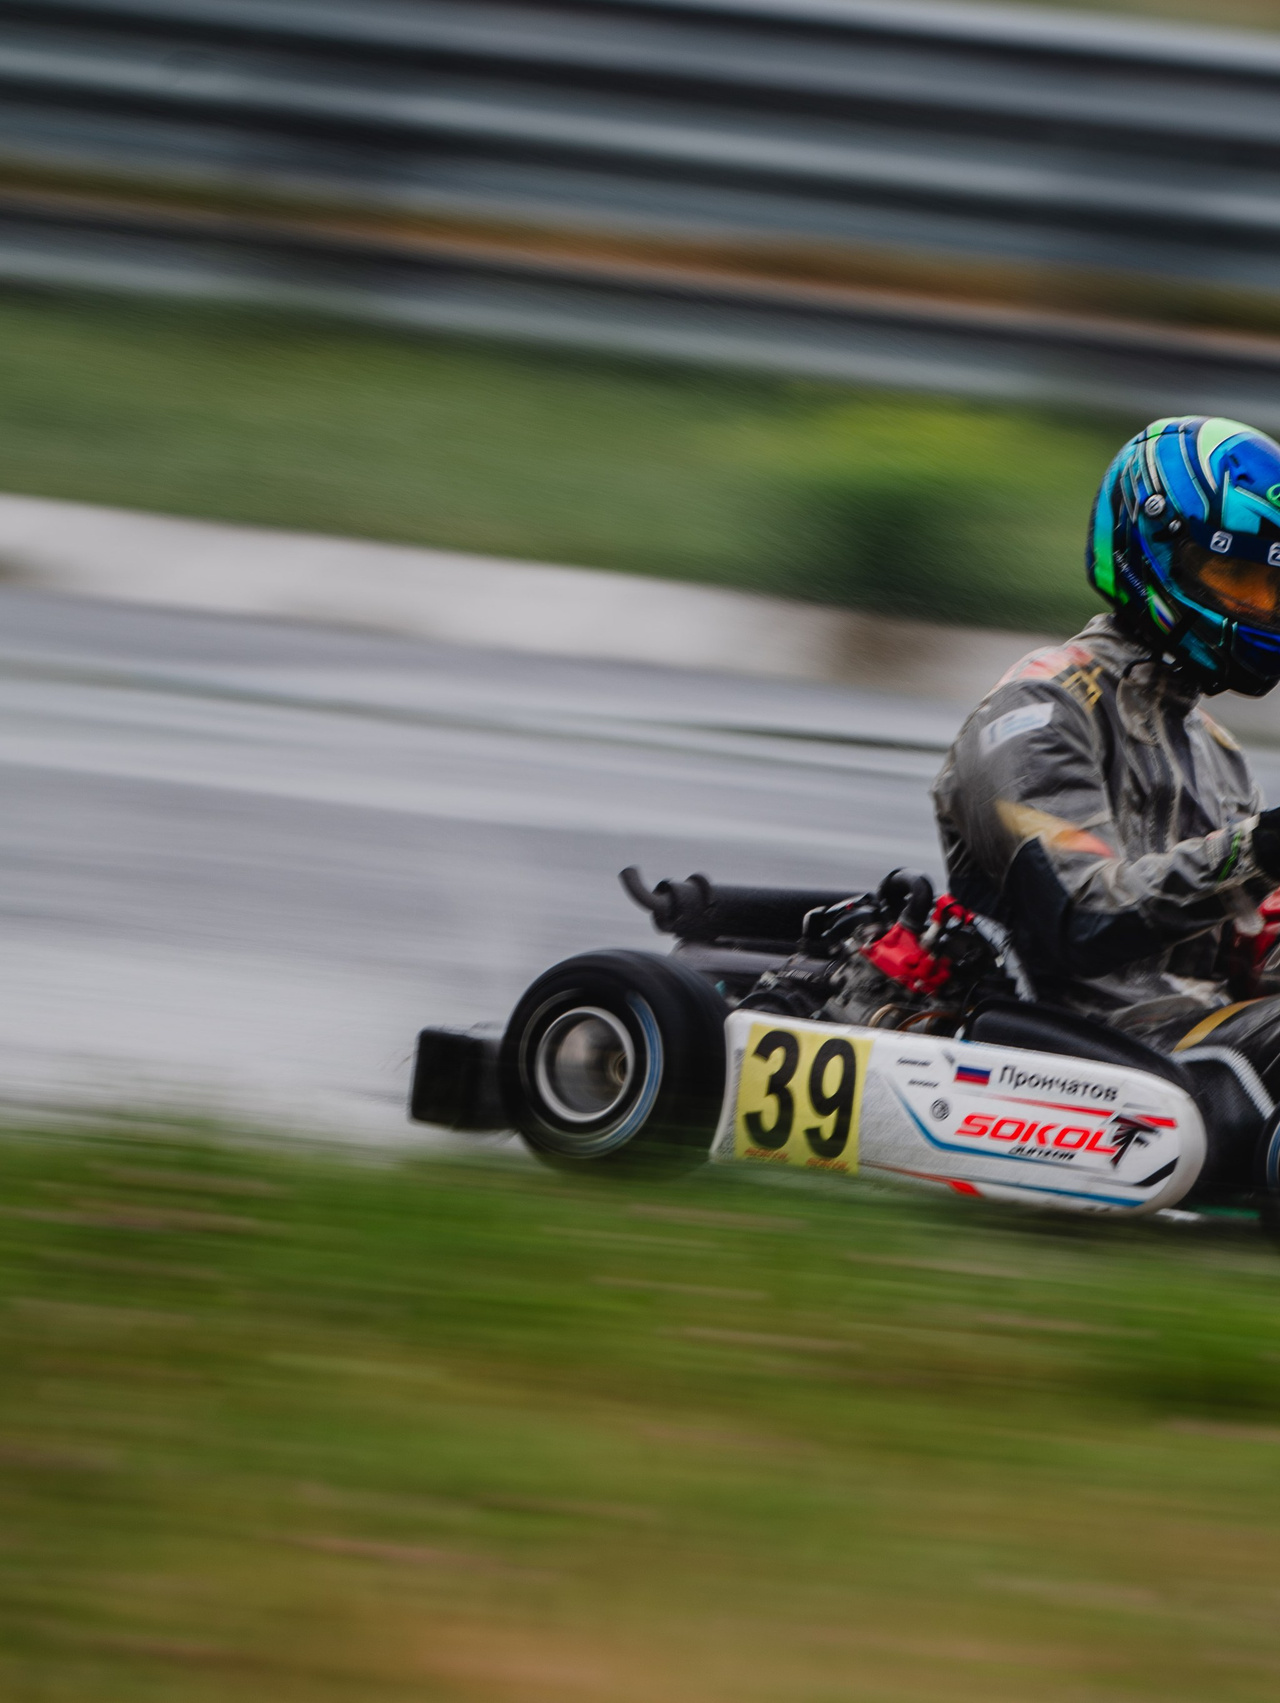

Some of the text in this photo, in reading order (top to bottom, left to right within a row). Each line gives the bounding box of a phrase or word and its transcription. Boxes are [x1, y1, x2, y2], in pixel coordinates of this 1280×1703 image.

[743, 1029, 857, 1159] 39
[1000, 1065, 1118, 1102] Прончатов
[954, 1113, 1119, 1158] SOKOL
